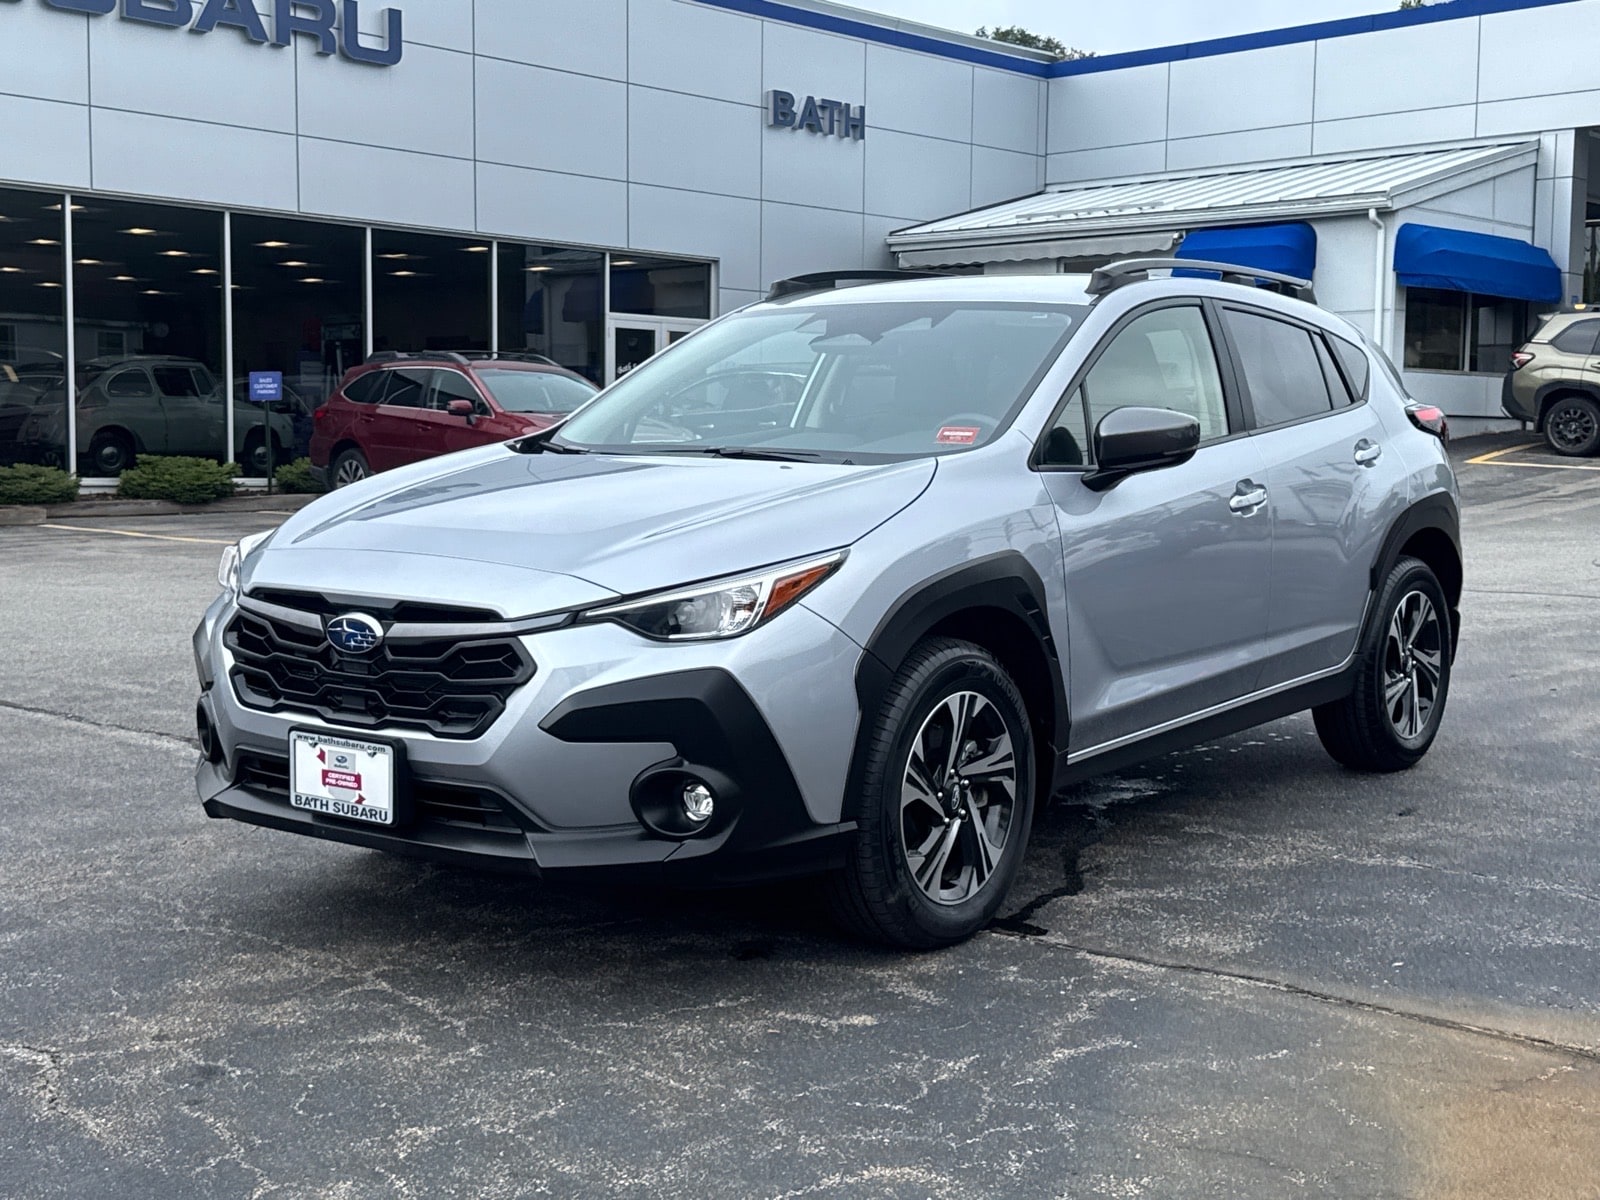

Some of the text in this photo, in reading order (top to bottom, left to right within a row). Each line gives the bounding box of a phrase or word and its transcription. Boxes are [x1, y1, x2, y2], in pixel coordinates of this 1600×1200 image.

[0, 0, 402, 66] ARU
[767, 89, 865, 140] BATH
[325, 778, 359, 788] PRE-OWNED
[327, 772, 356, 782] CERTIFIED
[294, 794, 388, 822] BATH SUBARU
